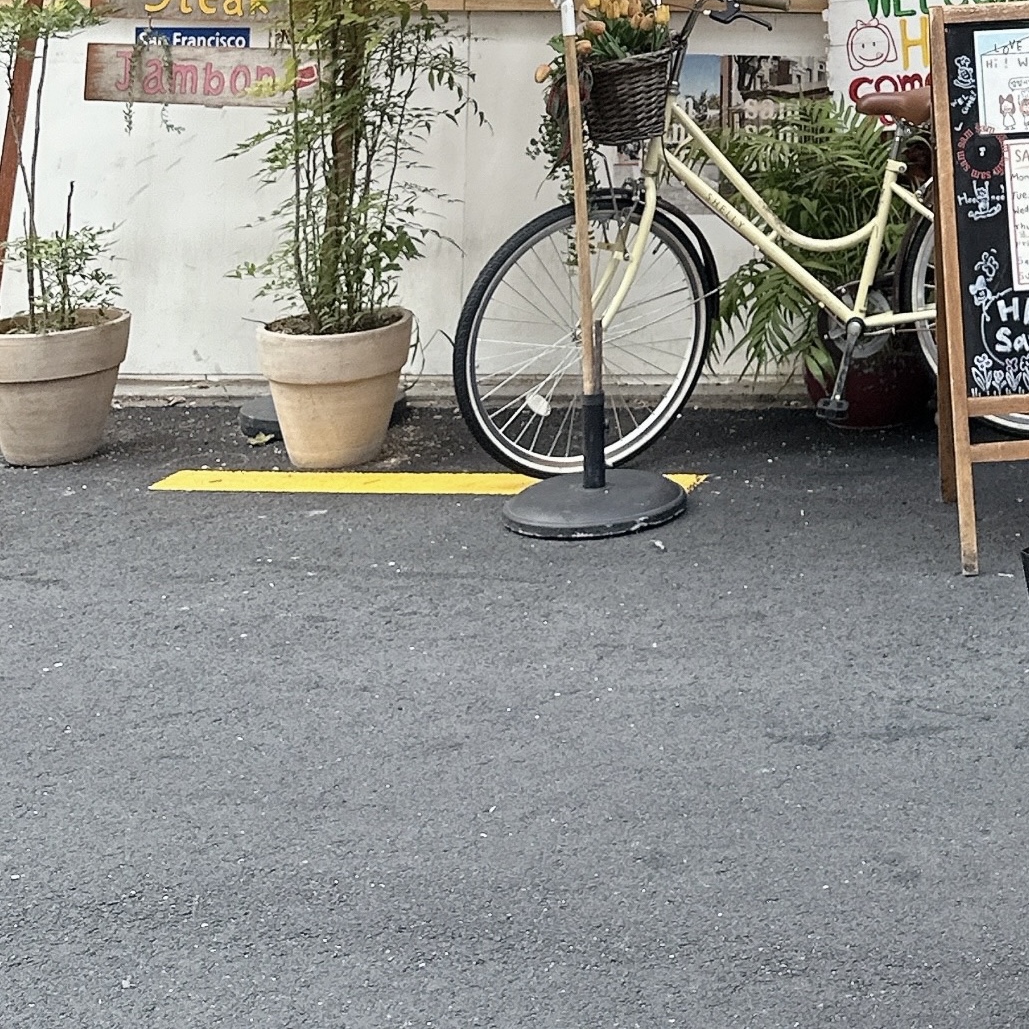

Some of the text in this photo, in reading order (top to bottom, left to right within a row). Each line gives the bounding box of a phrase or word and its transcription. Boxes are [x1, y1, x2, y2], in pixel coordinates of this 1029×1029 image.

[173, 31, 247, 48] Francisco
[115, 50, 276, 97] Jambon
[957, 129, 975, 150] sam
[970, 169, 992, 179] sam
[706, 192, 746, 229] SHELLY
